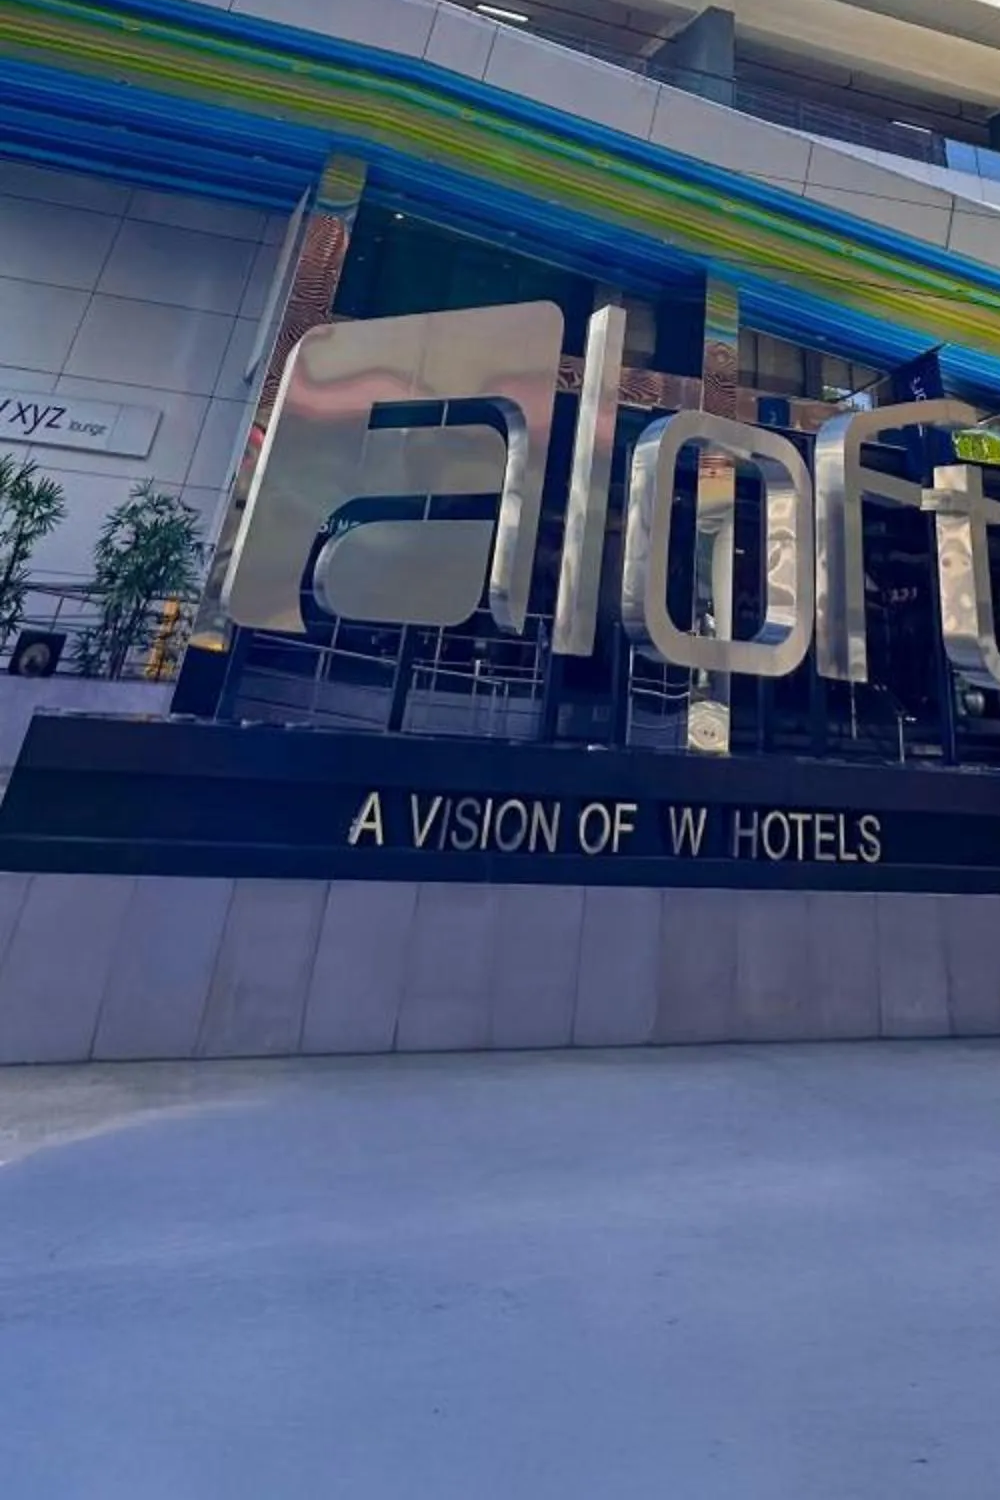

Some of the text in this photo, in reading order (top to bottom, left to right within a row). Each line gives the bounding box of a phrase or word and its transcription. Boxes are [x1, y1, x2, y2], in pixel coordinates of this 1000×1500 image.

[348, 792, 882, 864] A VISION OF W HOTELS
